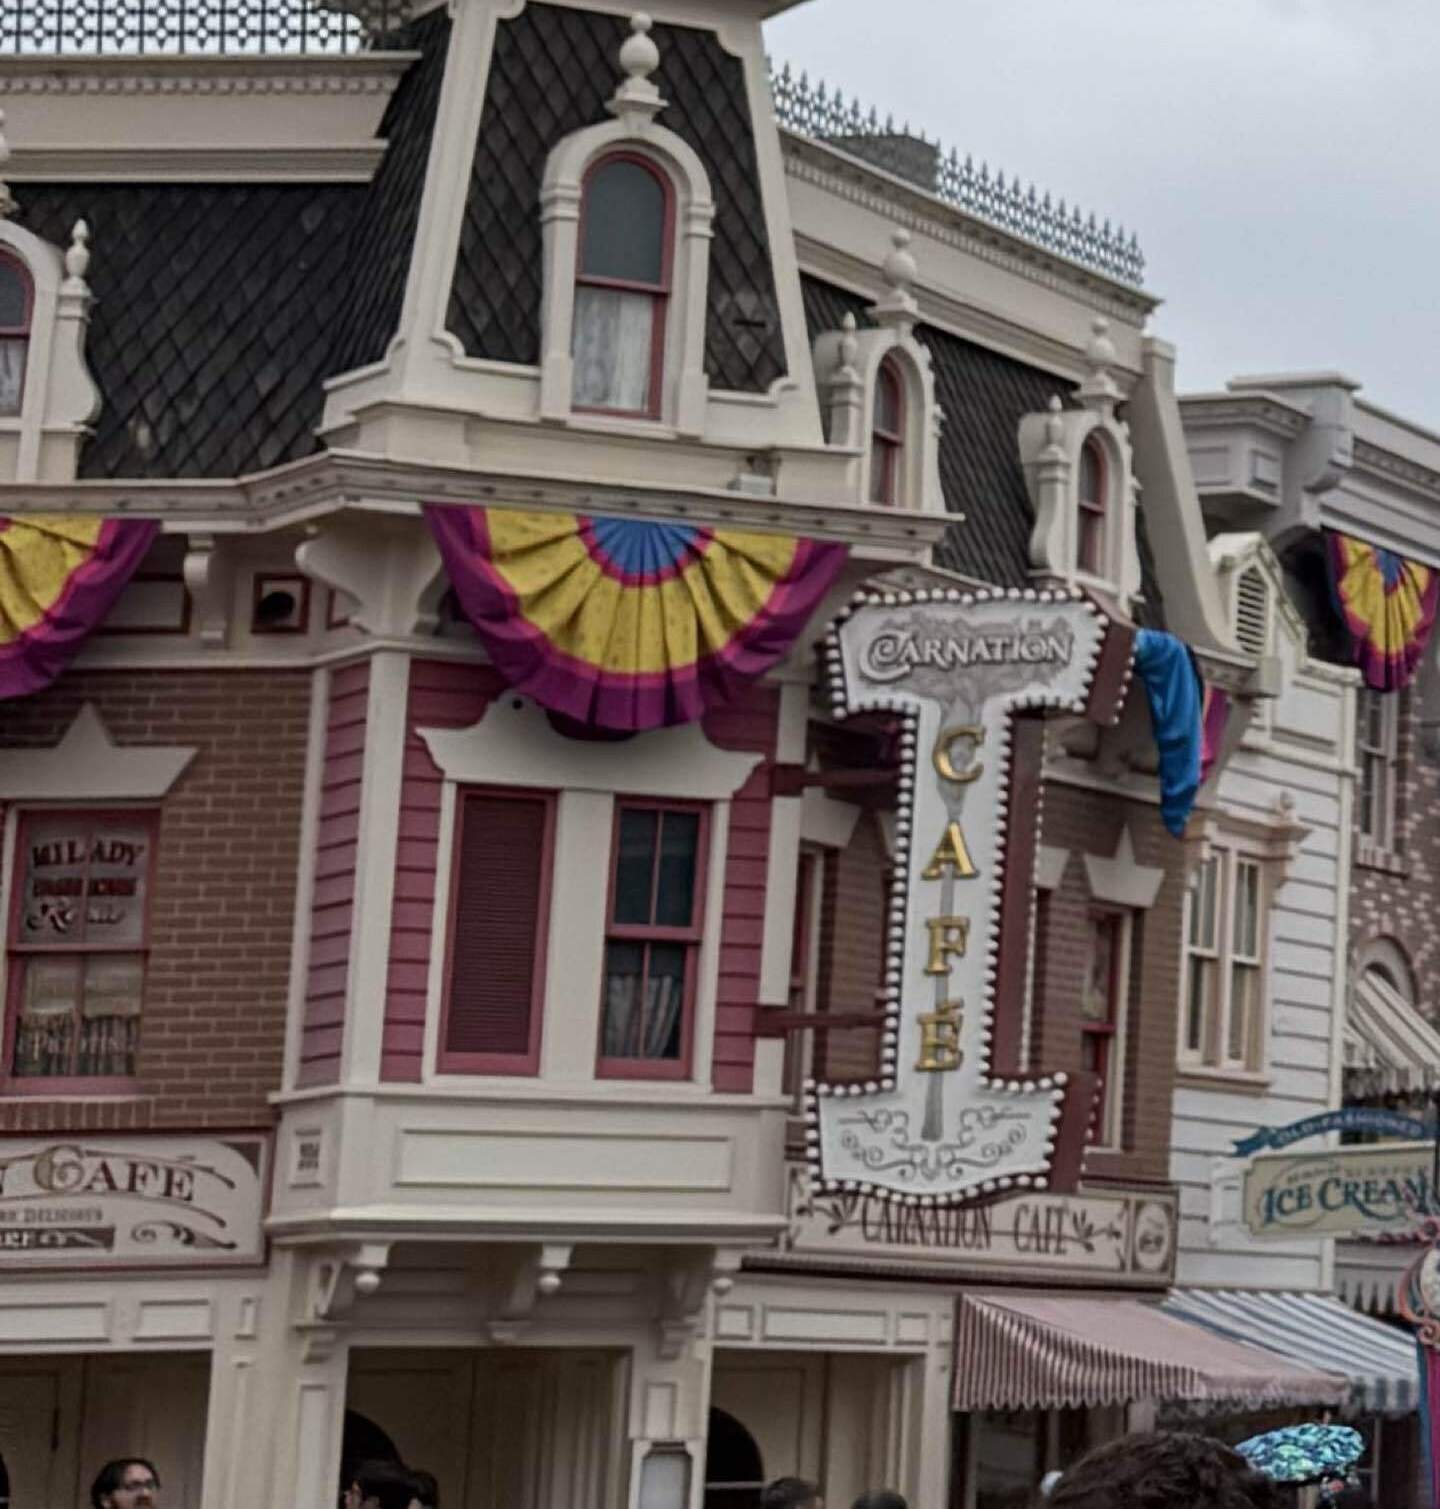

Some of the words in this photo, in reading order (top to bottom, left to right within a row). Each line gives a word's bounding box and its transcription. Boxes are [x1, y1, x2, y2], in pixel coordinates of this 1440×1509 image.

[859, 627, 1075, 682] CARNATION
[1264, 1183, 1313, 1225] ICE
[1317, 1166, 1432, 1221] CREAM
